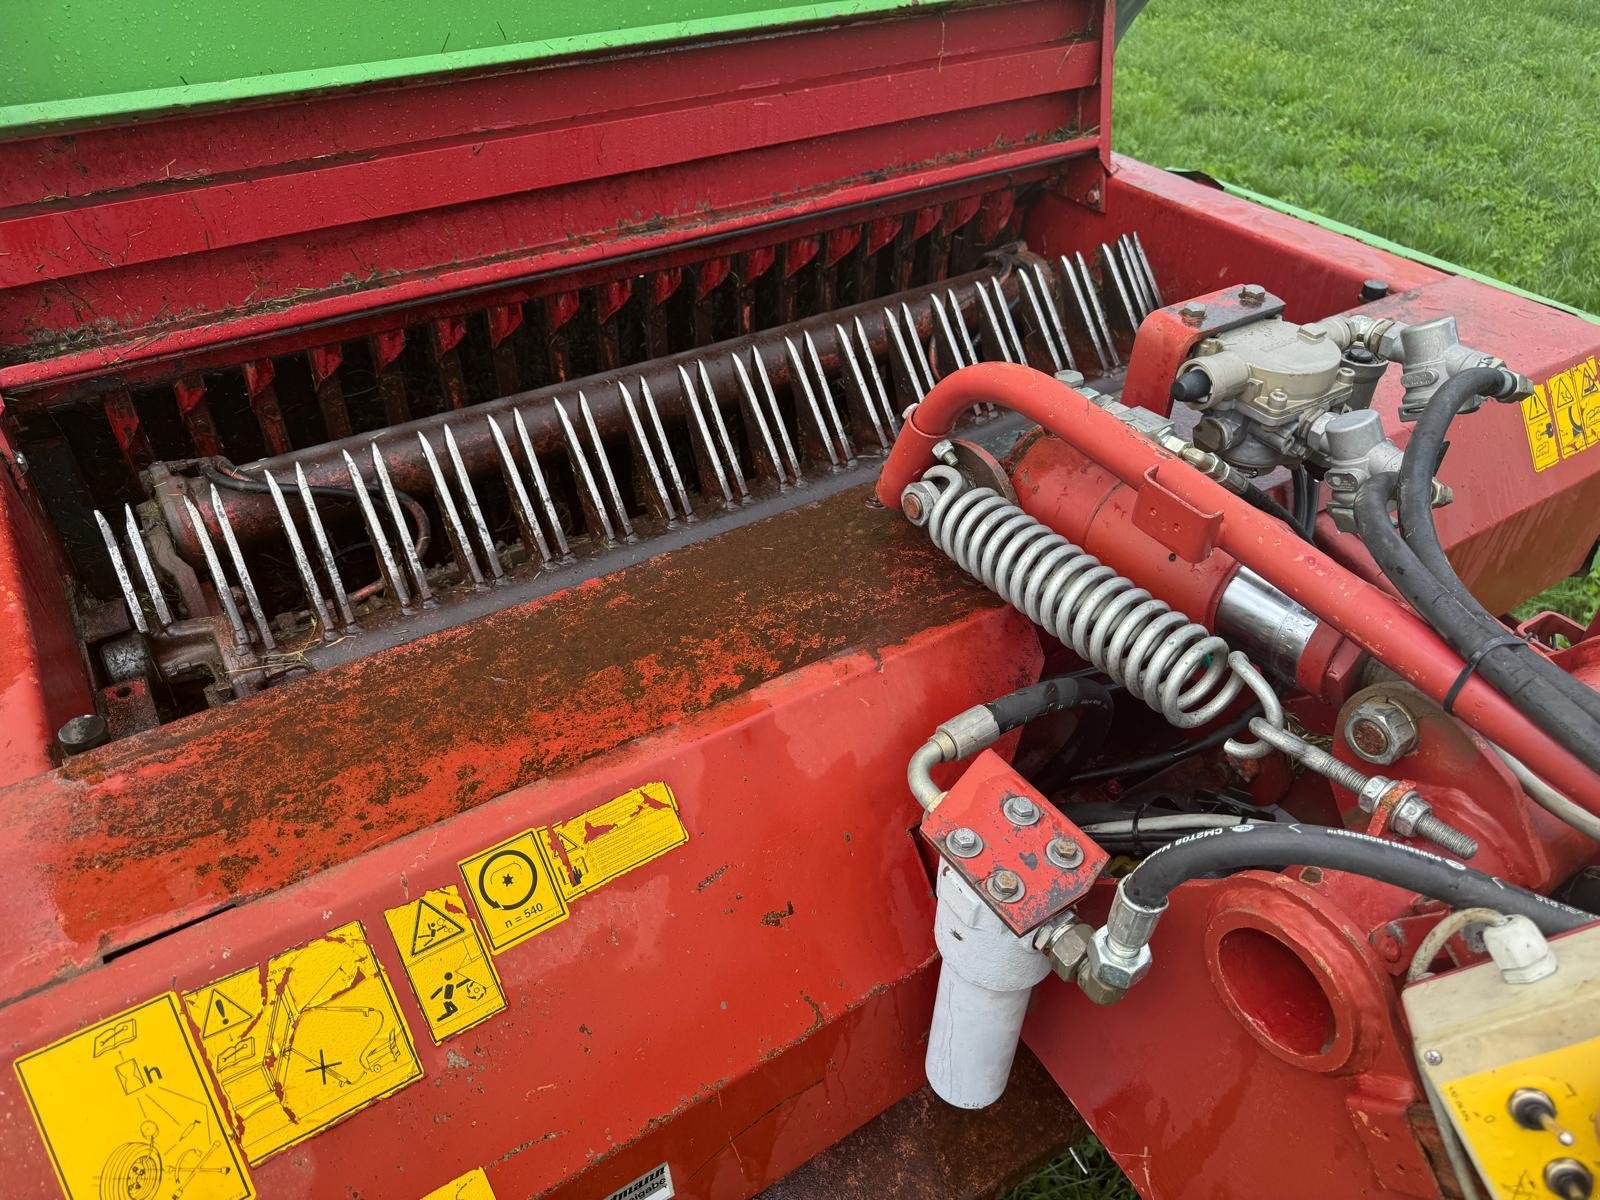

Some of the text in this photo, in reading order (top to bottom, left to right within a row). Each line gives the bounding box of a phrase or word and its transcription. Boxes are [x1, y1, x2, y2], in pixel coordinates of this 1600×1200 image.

[1175, 828, 1223, 846] CM2T08
[505, 919, 513, 928] n
[524, 902, 544, 918] 540
[143, 1065, 163, 1084] h
